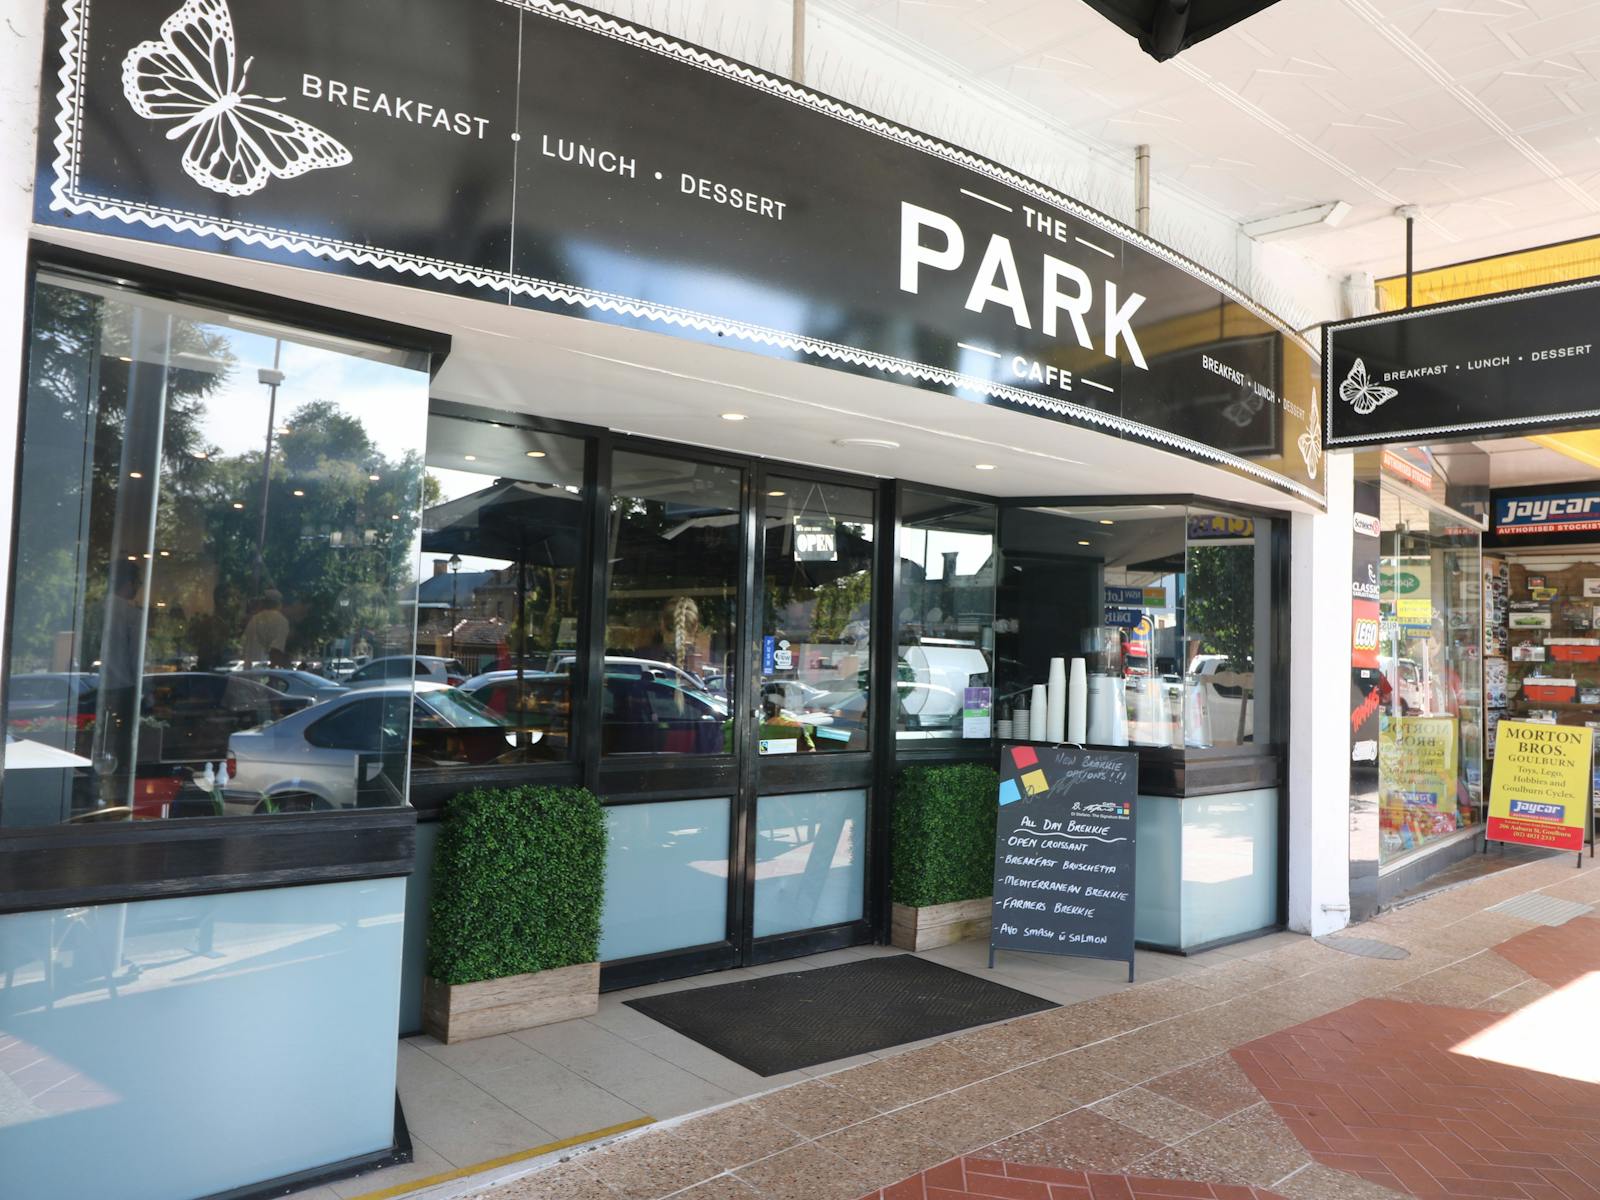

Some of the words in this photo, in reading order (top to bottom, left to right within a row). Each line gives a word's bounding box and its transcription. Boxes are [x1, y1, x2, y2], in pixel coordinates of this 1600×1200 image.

[302, 73, 490, 139] BREAKFAST
[542, 134, 636, 178] LUNCH
[680, 173, 787, 221] DESSERT
[1022, 205, 1067, 243] THE
[900, 201, 1149, 371] PARK
[1384, 364, 1448, 382] BREAKFAST
[1467, 356, 1510, 370] LUNCH
[1531, 344, 1592, 361] DESSERT
[1012, 355, 1073, 391] CAFE
[1202, 354, 1245, 387] BREAKFAST
[1254, 381, 1276, 404] LUNCH
[1283, 398, 1305, 421] DESSERT
[1499, 525, 1554, 535] AUTHORISED
[1557, 522, 1600, 532] STOCKIST
[797, 533, 835, 552] OPEN
[1352, 582, 1379, 595] CLASSIC
[1356, 623, 1377, 647] LEGO
[1506, 728, 1582, 744] MORTON
[1519, 742, 1566, 757] BROS.
[1508, 754, 1575, 768] GOULBURN
[1502, 783, 1544, 796] Goulburn
[1513, 775, 1548, 786] Hobbies
[1549, 780, 1566, 788] and
[1043, 819, 1062, 832] DAY
[1067, 820, 1111, 836] BREKKIE
[1008, 836, 1038, 848] OPEN
[1041, 840, 1088, 851] CROISSANT
[1004, 854, 1058, 868] BREAKFAST
[1062, 860, 1117, 874] BRUSCHETTA
[1004, 875, 1081, 894] MEDITERRANEAN
[1085, 886, 1129, 901] BREKKIE
[1002, 897, 1046, 912] FARMERS
[1054, 902, 1096, 918] BREKKIE
[1023, 927, 1055, 939] SMASH
[1068, 933, 1107, 944] SALMON
